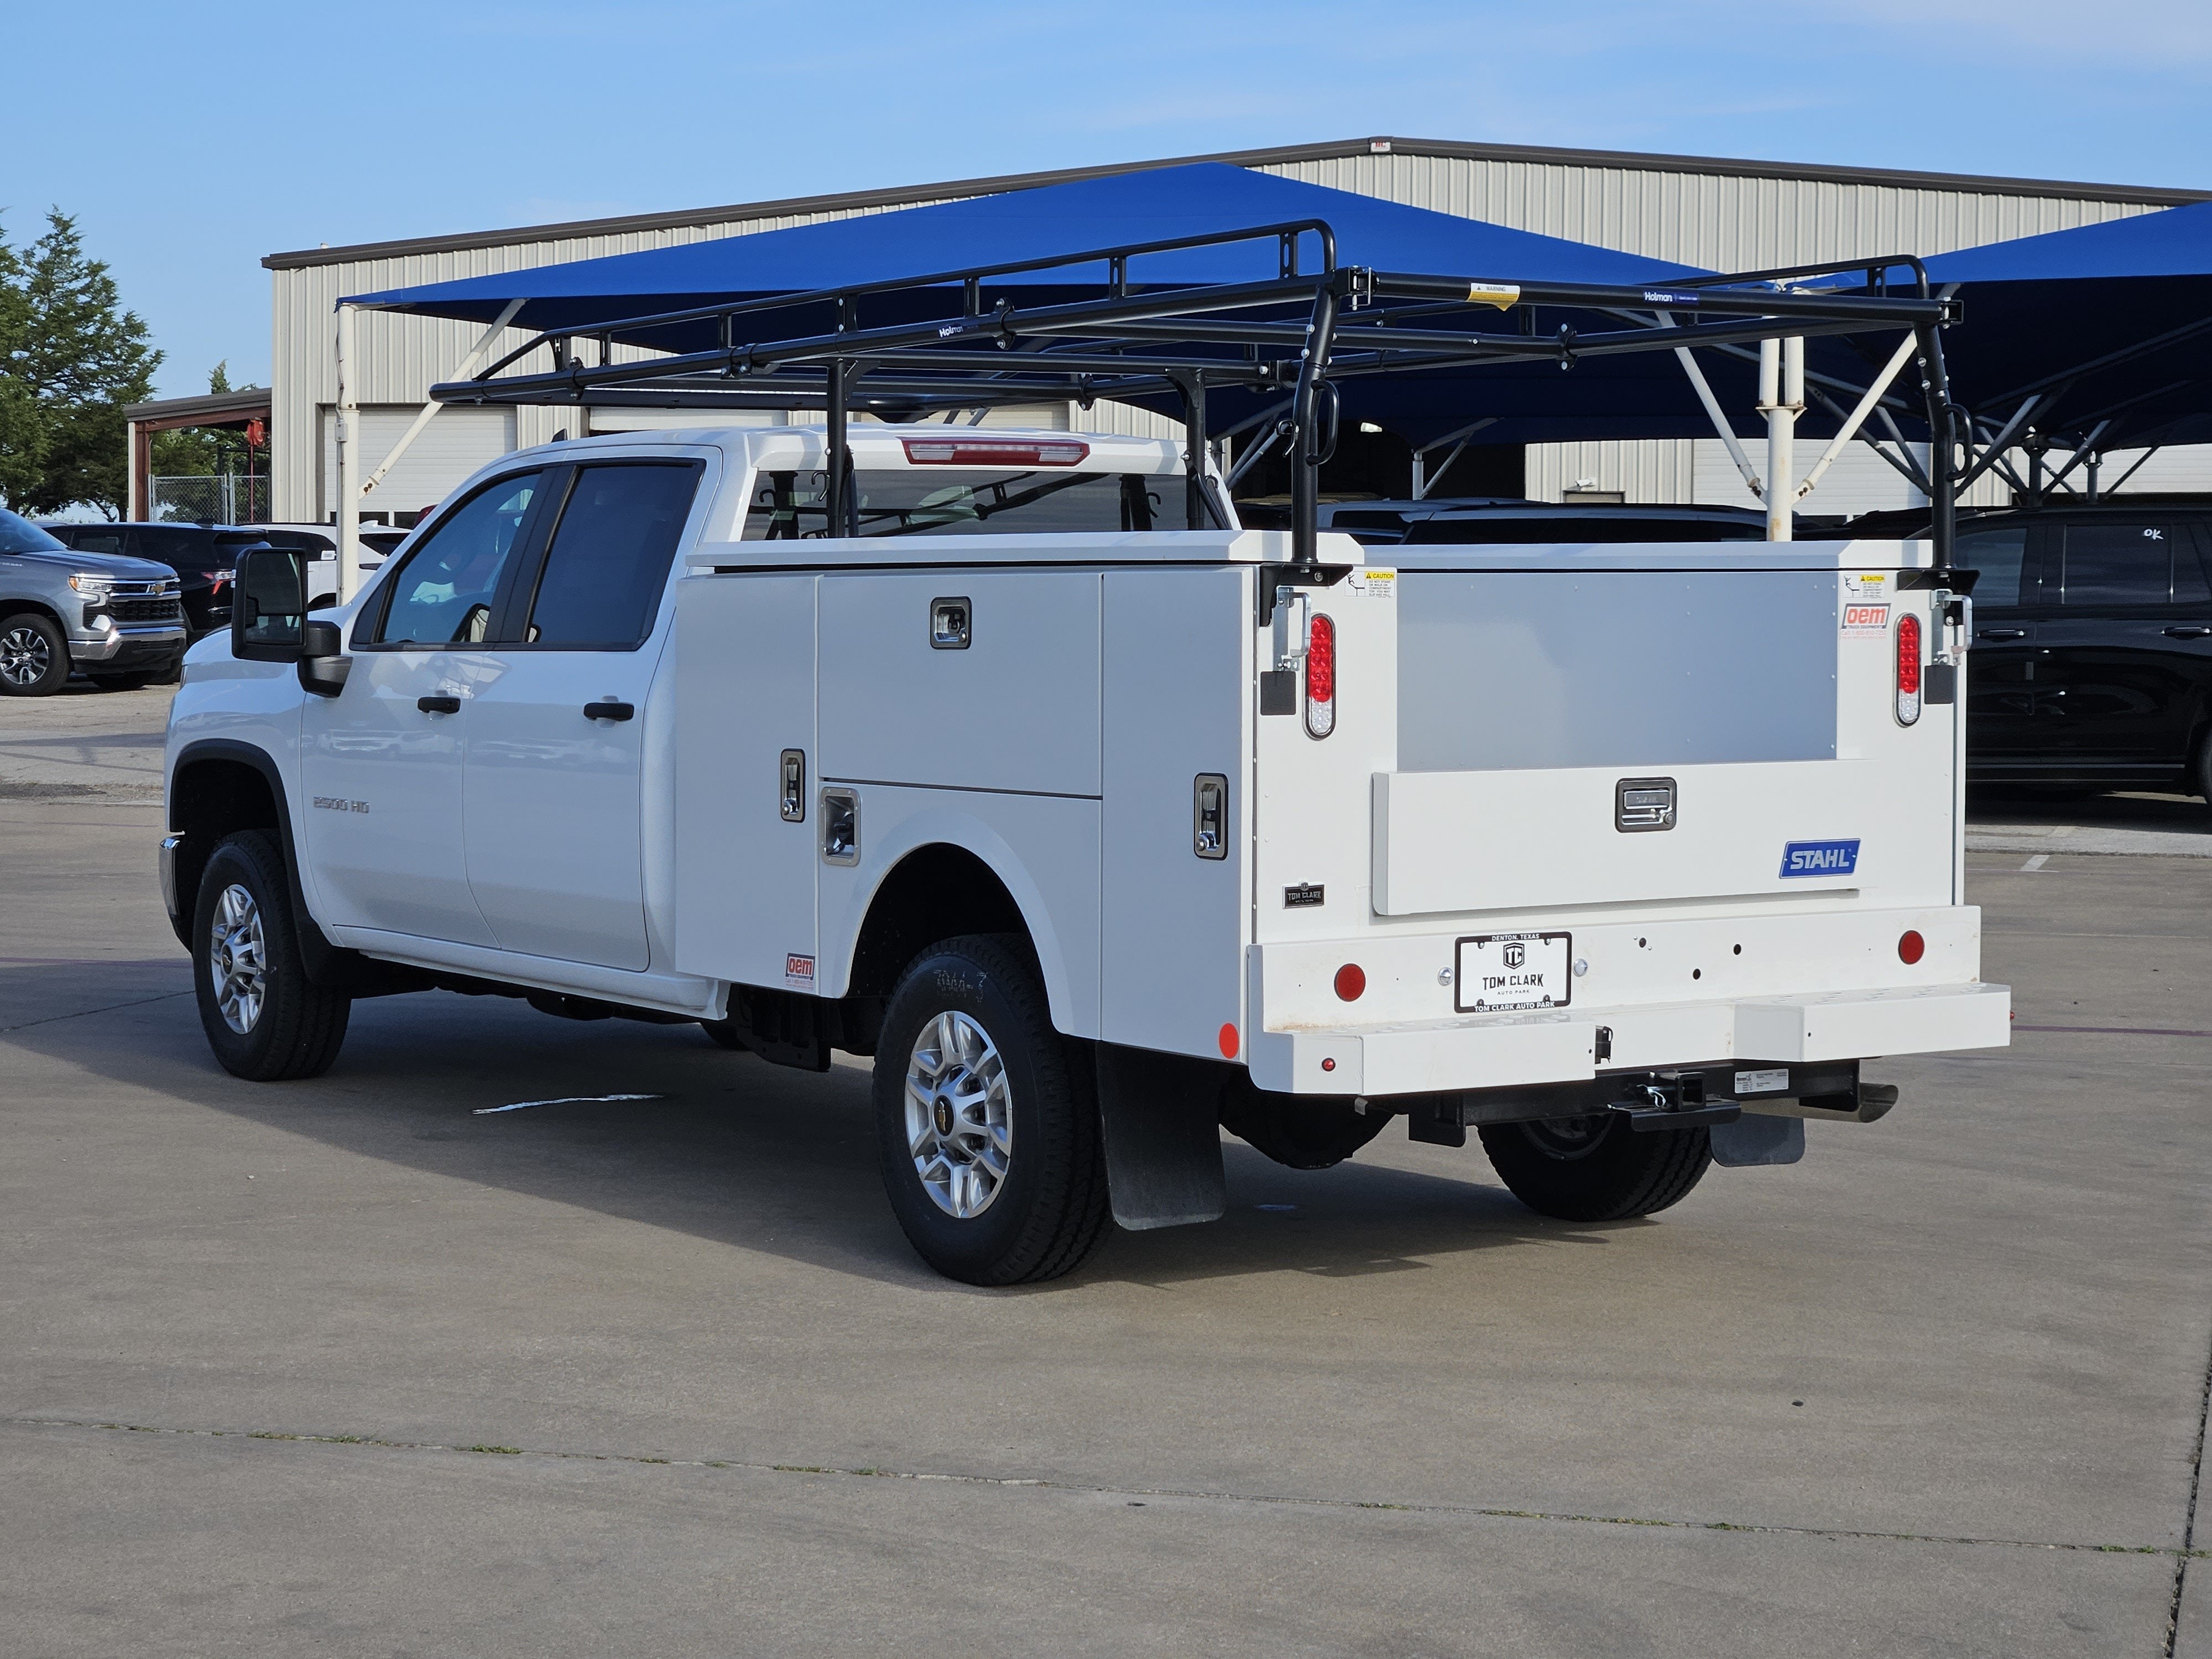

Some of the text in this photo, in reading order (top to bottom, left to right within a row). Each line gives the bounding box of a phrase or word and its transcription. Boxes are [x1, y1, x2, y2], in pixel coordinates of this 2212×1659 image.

[1645, 291, 1673, 302] Holman
[939, 326, 964, 337] Holman
[2144, 529, 2164, 540] OK
[1846, 608, 1886, 624] oem
[313, 796, 369, 813] 2500 HD
[1790, 849, 1850, 869] STAHL
[1287, 893, 1300, 901] TOM
[1506, 948, 1522, 964] TC
[789, 958, 812, 975] oem
[1483, 974, 1544, 990] TOM CLARK
